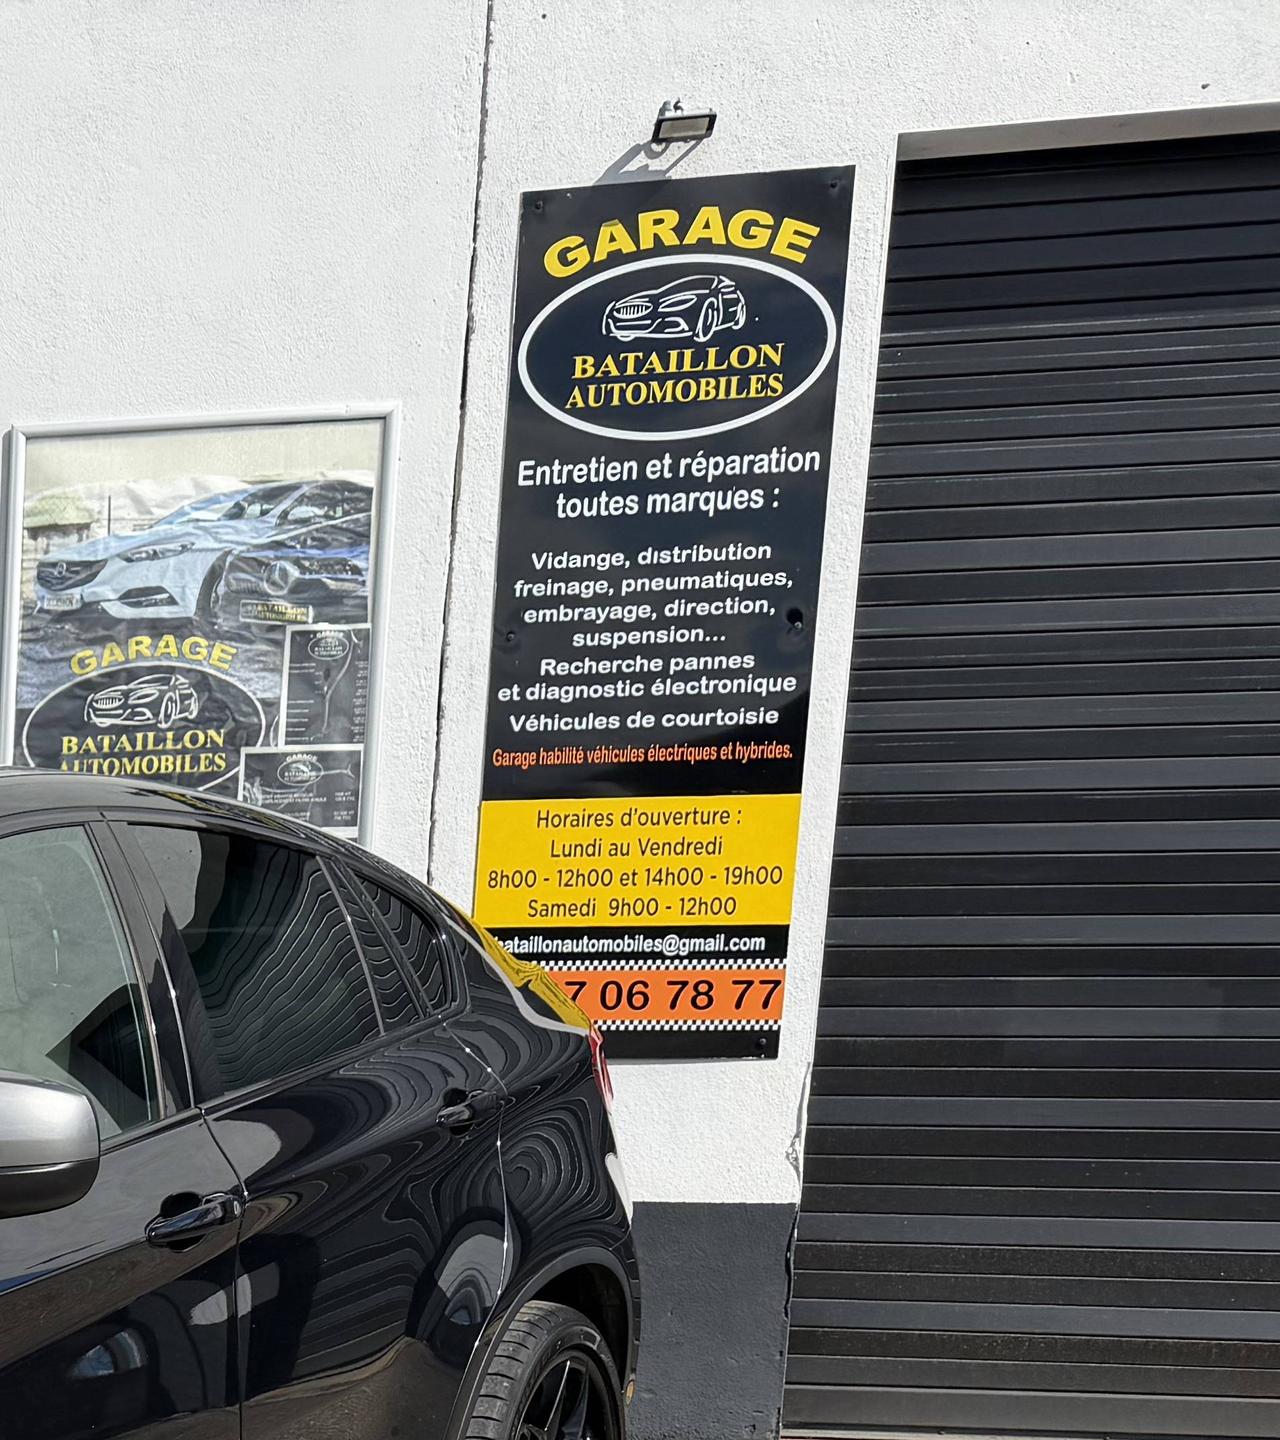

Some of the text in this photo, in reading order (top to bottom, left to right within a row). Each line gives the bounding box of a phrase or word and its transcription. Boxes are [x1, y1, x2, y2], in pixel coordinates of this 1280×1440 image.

[544, 206, 820, 278] GARAGE
[572, 343, 784, 379] BATAILLON
[565, 373, 784, 409] AUTOMOBILES
[518, 448, 821, 486] Entretien et réparation
[556, 492, 639, 519] toutes
[647, 488, 763, 518] marques
[532, 543, 771, 572] Vidange, distribution
[514, 569, 793, 598] freinage, pneumatiques,
[523, 598, 776, 626] embrayage, direction,
[572, 626, 726, 649] suspension...
[71, 635, 238, 676] GARAGE
[540, 653, 755, 676] Recherche pannes
[497, 674, 797, 703] et diagnostic électronique
[510, 708, 779, 733] Véhicules de courtoisie
[62, 728, 225, 756] BATAILLON
[492, 740, 793, 770] Garage habilité véhicules électriques et hybrides.
[59, 752, 227, 776] AUTOMOBILES
[536, 808, 614, 829] Horaires
[620, 807, 730, 827] d'ouverture
[550, 836, 723, 859] Lundi au Vendredi
[487, 869, 537, 889] 8h00
[557, 868, 613, 888] 12h00
[619, 869, 639, 886] et
[644, 867, 703, 887] 14h00
[724, 866, 783, 885] 19h00
[527, 898, 597, 919] Samedi
[608, 897, 659, 917] 9h00
[678, 896, 737, 916] 12h00
[600, 980, 650, 1010] 06
[666, 980, 714, 1010] 78
[731, 979, 782, 1010] 77
